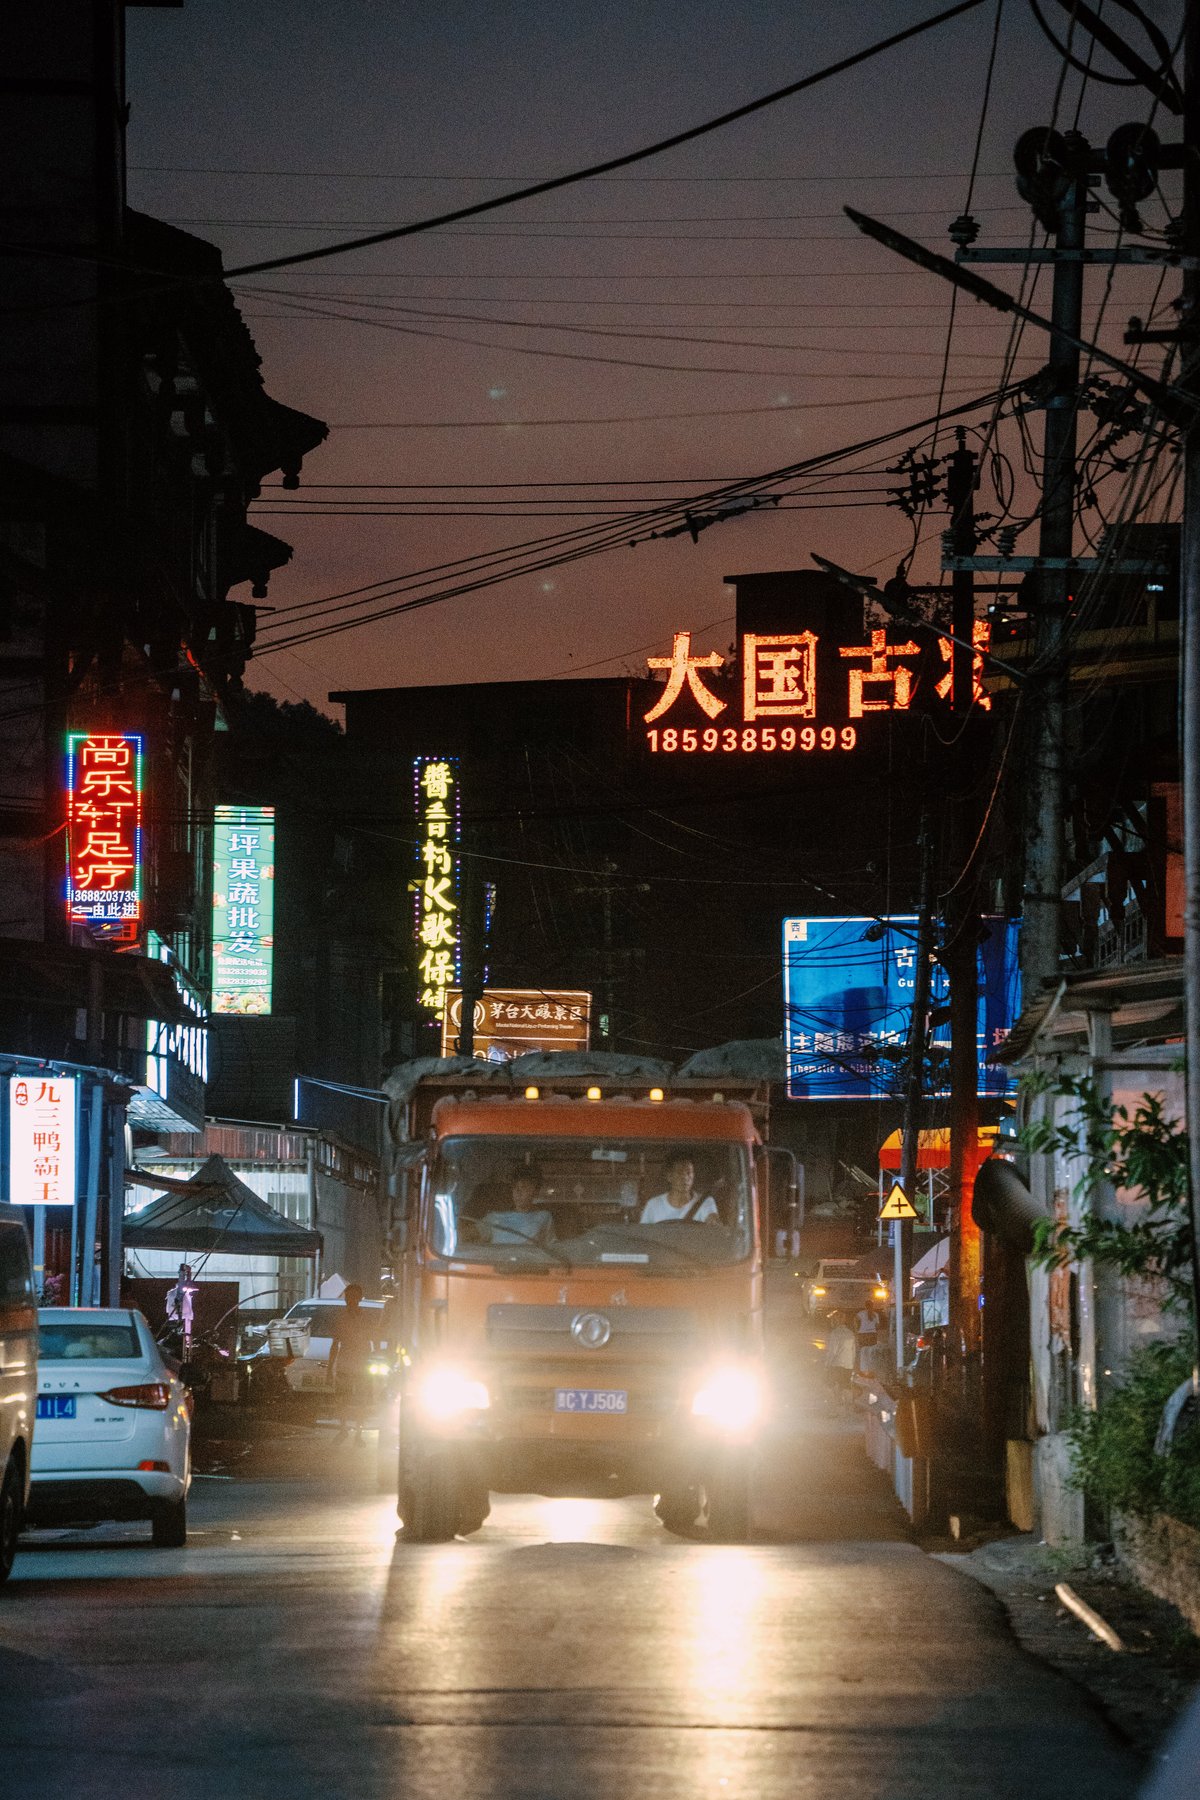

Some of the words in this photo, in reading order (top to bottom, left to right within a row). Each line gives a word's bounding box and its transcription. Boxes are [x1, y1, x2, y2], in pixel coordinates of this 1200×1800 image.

[647, 726, 857, 753] 18593859999
[71, 890, 137, 902] 13688203739
[93, 902, 137, 917] 由此进
[33, 1081, 61, 1202] 九三鸭霸王
